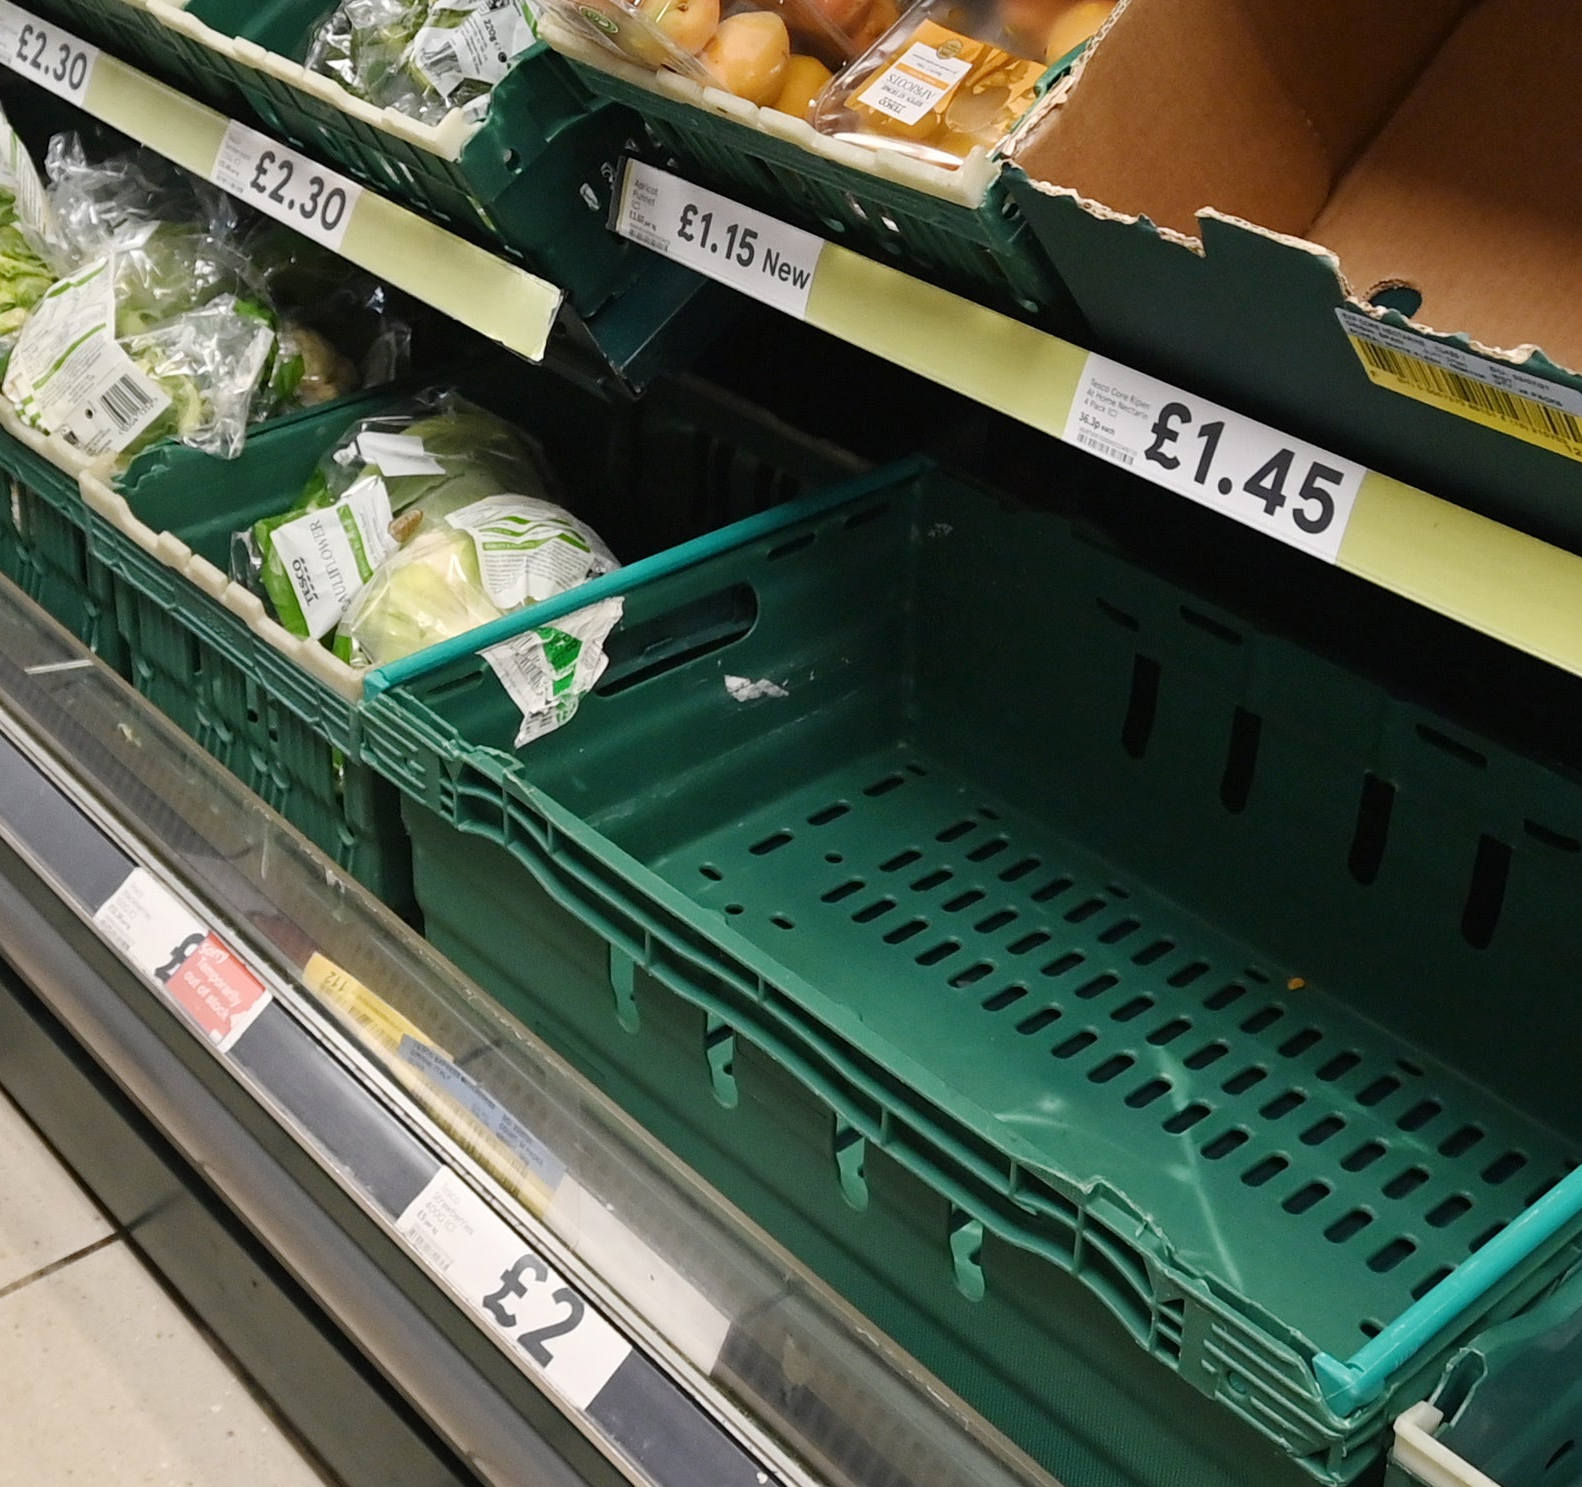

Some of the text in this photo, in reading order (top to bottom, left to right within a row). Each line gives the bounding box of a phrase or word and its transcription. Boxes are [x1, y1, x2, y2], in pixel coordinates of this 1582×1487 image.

[483, 18, 497, 42] 220g
[16, 23, 88, 91] £2.30
[878, 98, 906, 114] TESCO
[886, 73, 936, 101] APRICOTS
[250, 150, 347, 231] £2.30
[633, 189, 655, 206] Punnet
[635, 180, 658, 196] Apricot
[678, 204, 810, 290] £1.15 New
[1083, 398, 1088, 406] 4
[1089, 401, 1106, 413] Pack
[1087, 388, 1094, 397] At
[1096, 392, 1117, 407] Home
[1090, 378, 1151, 410] Tesco Core Ripen
[1078, 411, 1115, 436] 36.3p each
[1144, 402, 1344, 534] £1.45
[292, 559, 315, 607] TESCO
[309, 520, 352, 612] CAULIFLOWER
[184, 972, 229, 1020] out of stock
[197, 956, 242, 1008] Temporarily
[482, 1254, 585, 1369] £2
